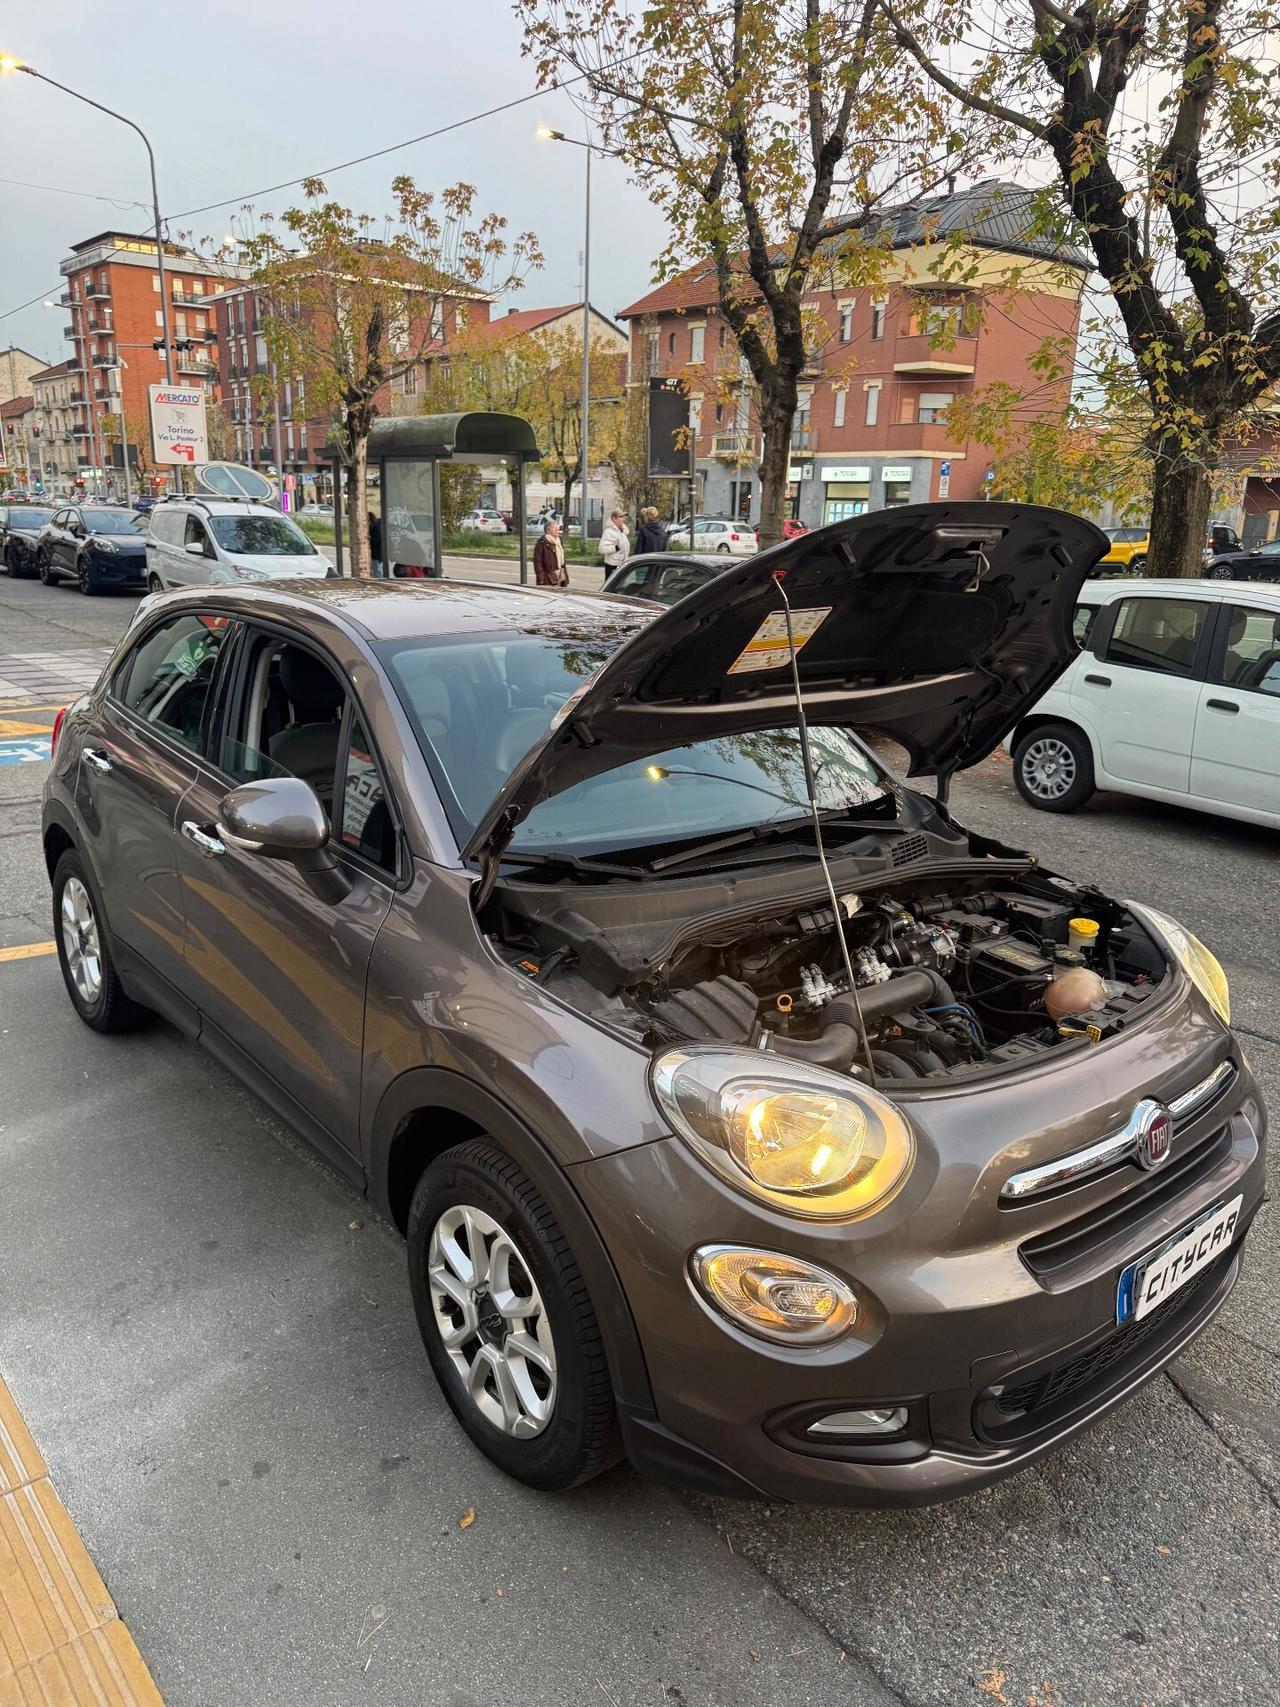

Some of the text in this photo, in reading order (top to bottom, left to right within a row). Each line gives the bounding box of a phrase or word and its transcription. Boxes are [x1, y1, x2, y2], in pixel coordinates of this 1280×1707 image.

[168, 425, 194, 435] Torino
[1151, 1122, 1168, 1155] FIAT
[1146, 1210, 1238, 1304] CITYCAR
